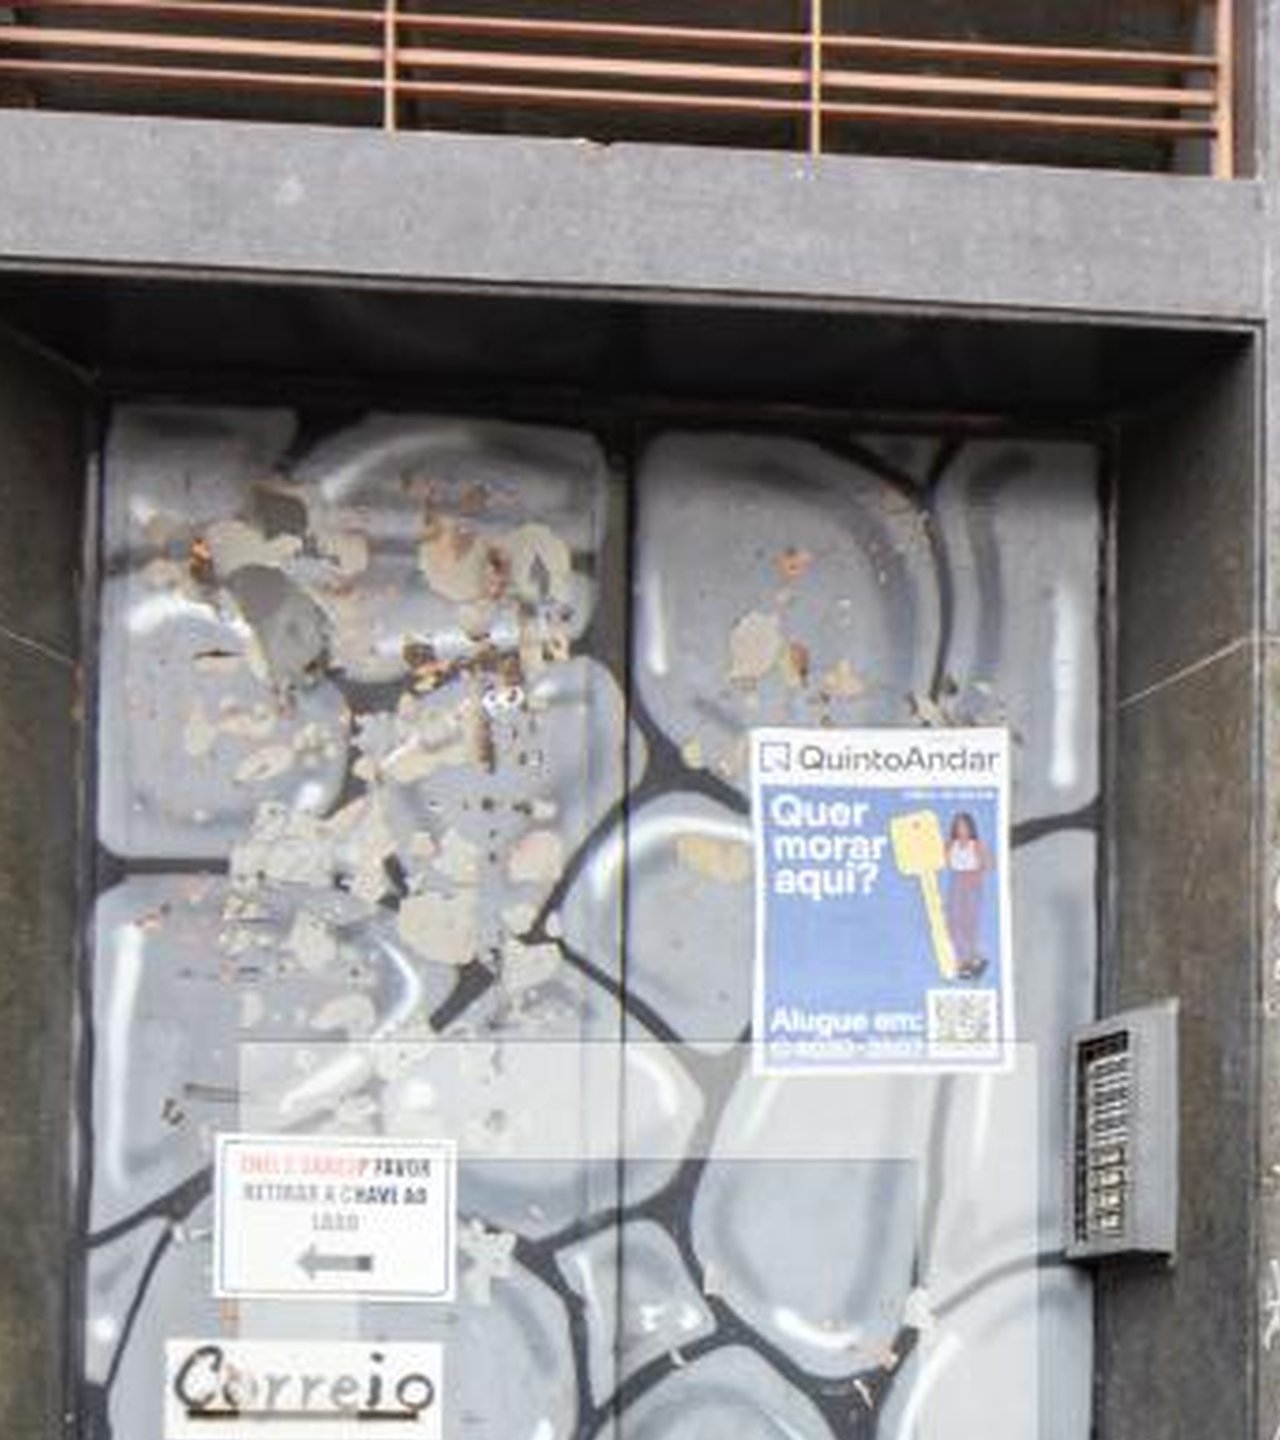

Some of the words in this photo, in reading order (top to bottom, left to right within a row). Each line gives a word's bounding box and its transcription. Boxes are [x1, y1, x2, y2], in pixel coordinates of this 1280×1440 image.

[799, 744, 999, 772] QuintoAndar
[772, 794, 870, 828] Quer
[773, 833, 888, 861] morar
[773, 863, 879, 901] aqui?
[770, 1007, 866, 1038] Alugue
[875, 1011, 922, 1033] em:
[373, 1157, 432, 1178] FAVOR
[243, 1182, 319, 1201] RETIRAR
[325, 1184, 335, 1201] A
[339, 1184, 399, 1206] CHAVE
[403, 1186, 429, 1206] AO
[311, 1210, 360, 1232] LADO
[173, 1344, 436, 1414] Correio
